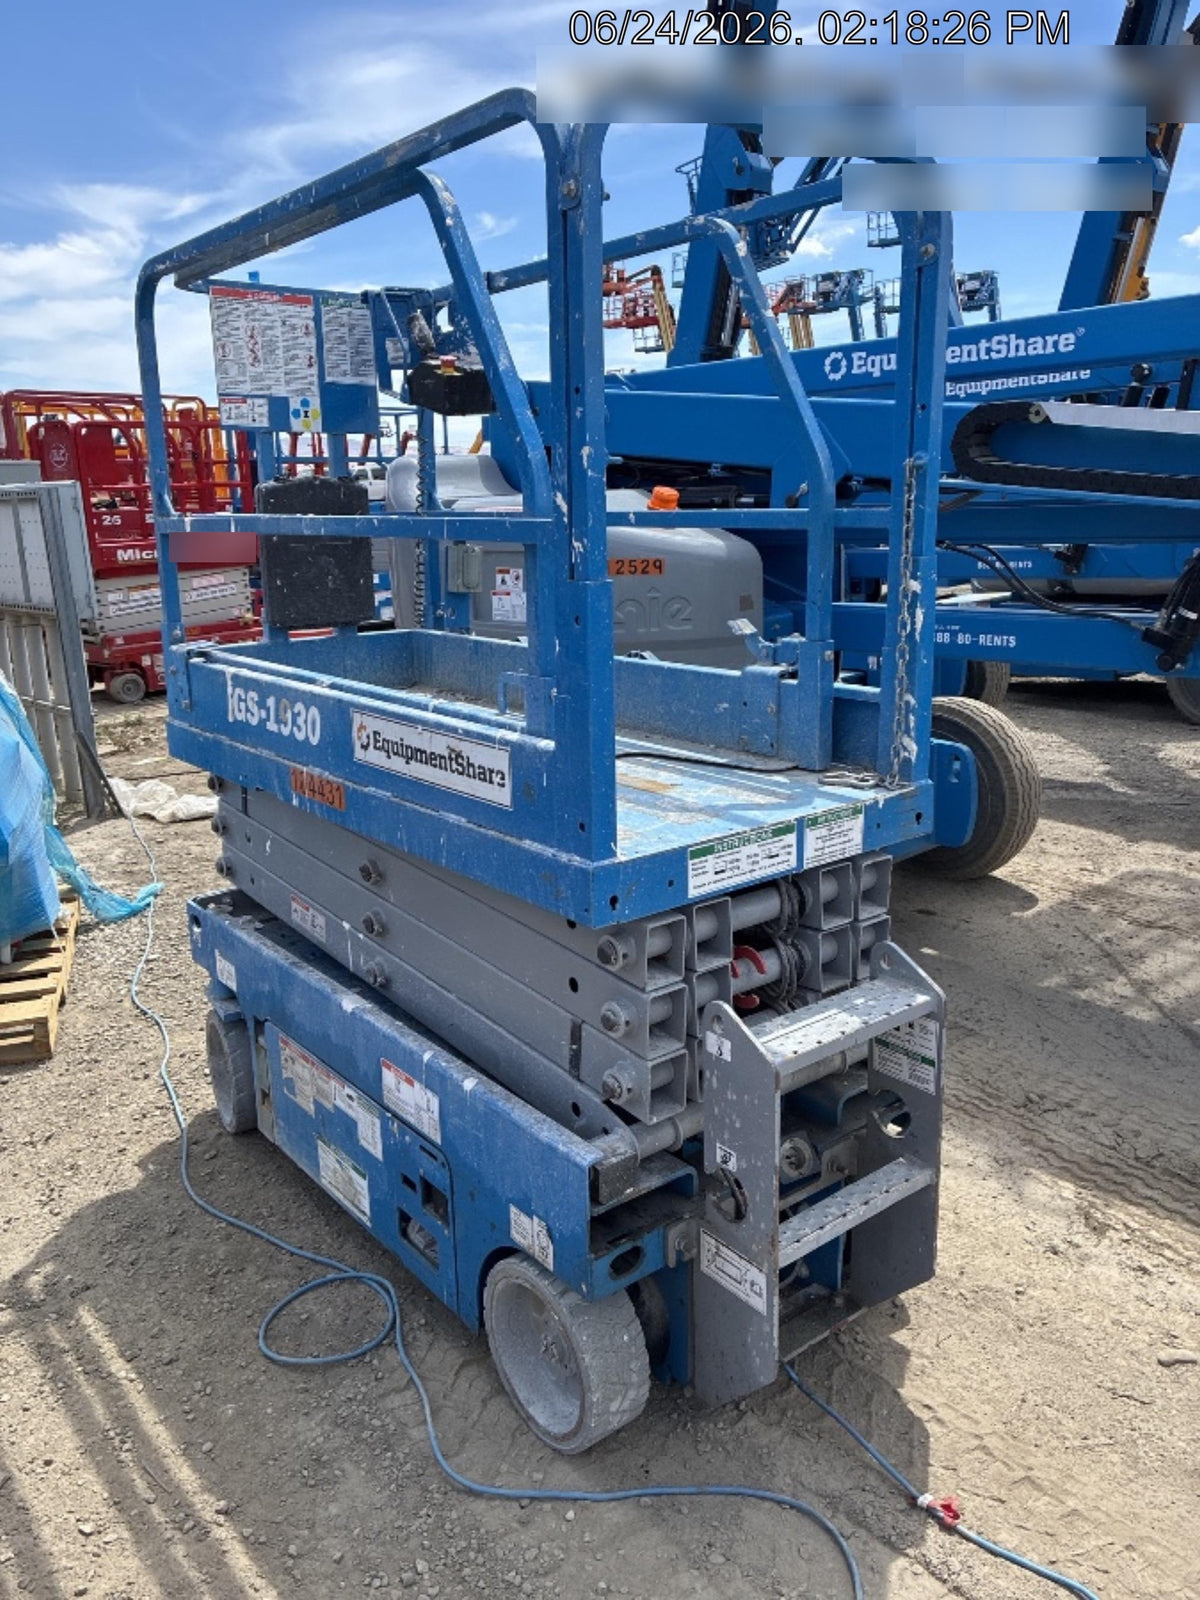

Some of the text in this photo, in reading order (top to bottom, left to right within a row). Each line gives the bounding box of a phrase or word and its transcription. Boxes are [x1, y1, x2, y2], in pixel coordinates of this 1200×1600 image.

[851, 331, 1076, 378] EquentShare
[615, 559, 662, 575] 2529
[613, 586, 692, 632] nie
[233, 686, 321, 746] GS-1930
[371, 730, 507, 788] EquipmentShare
